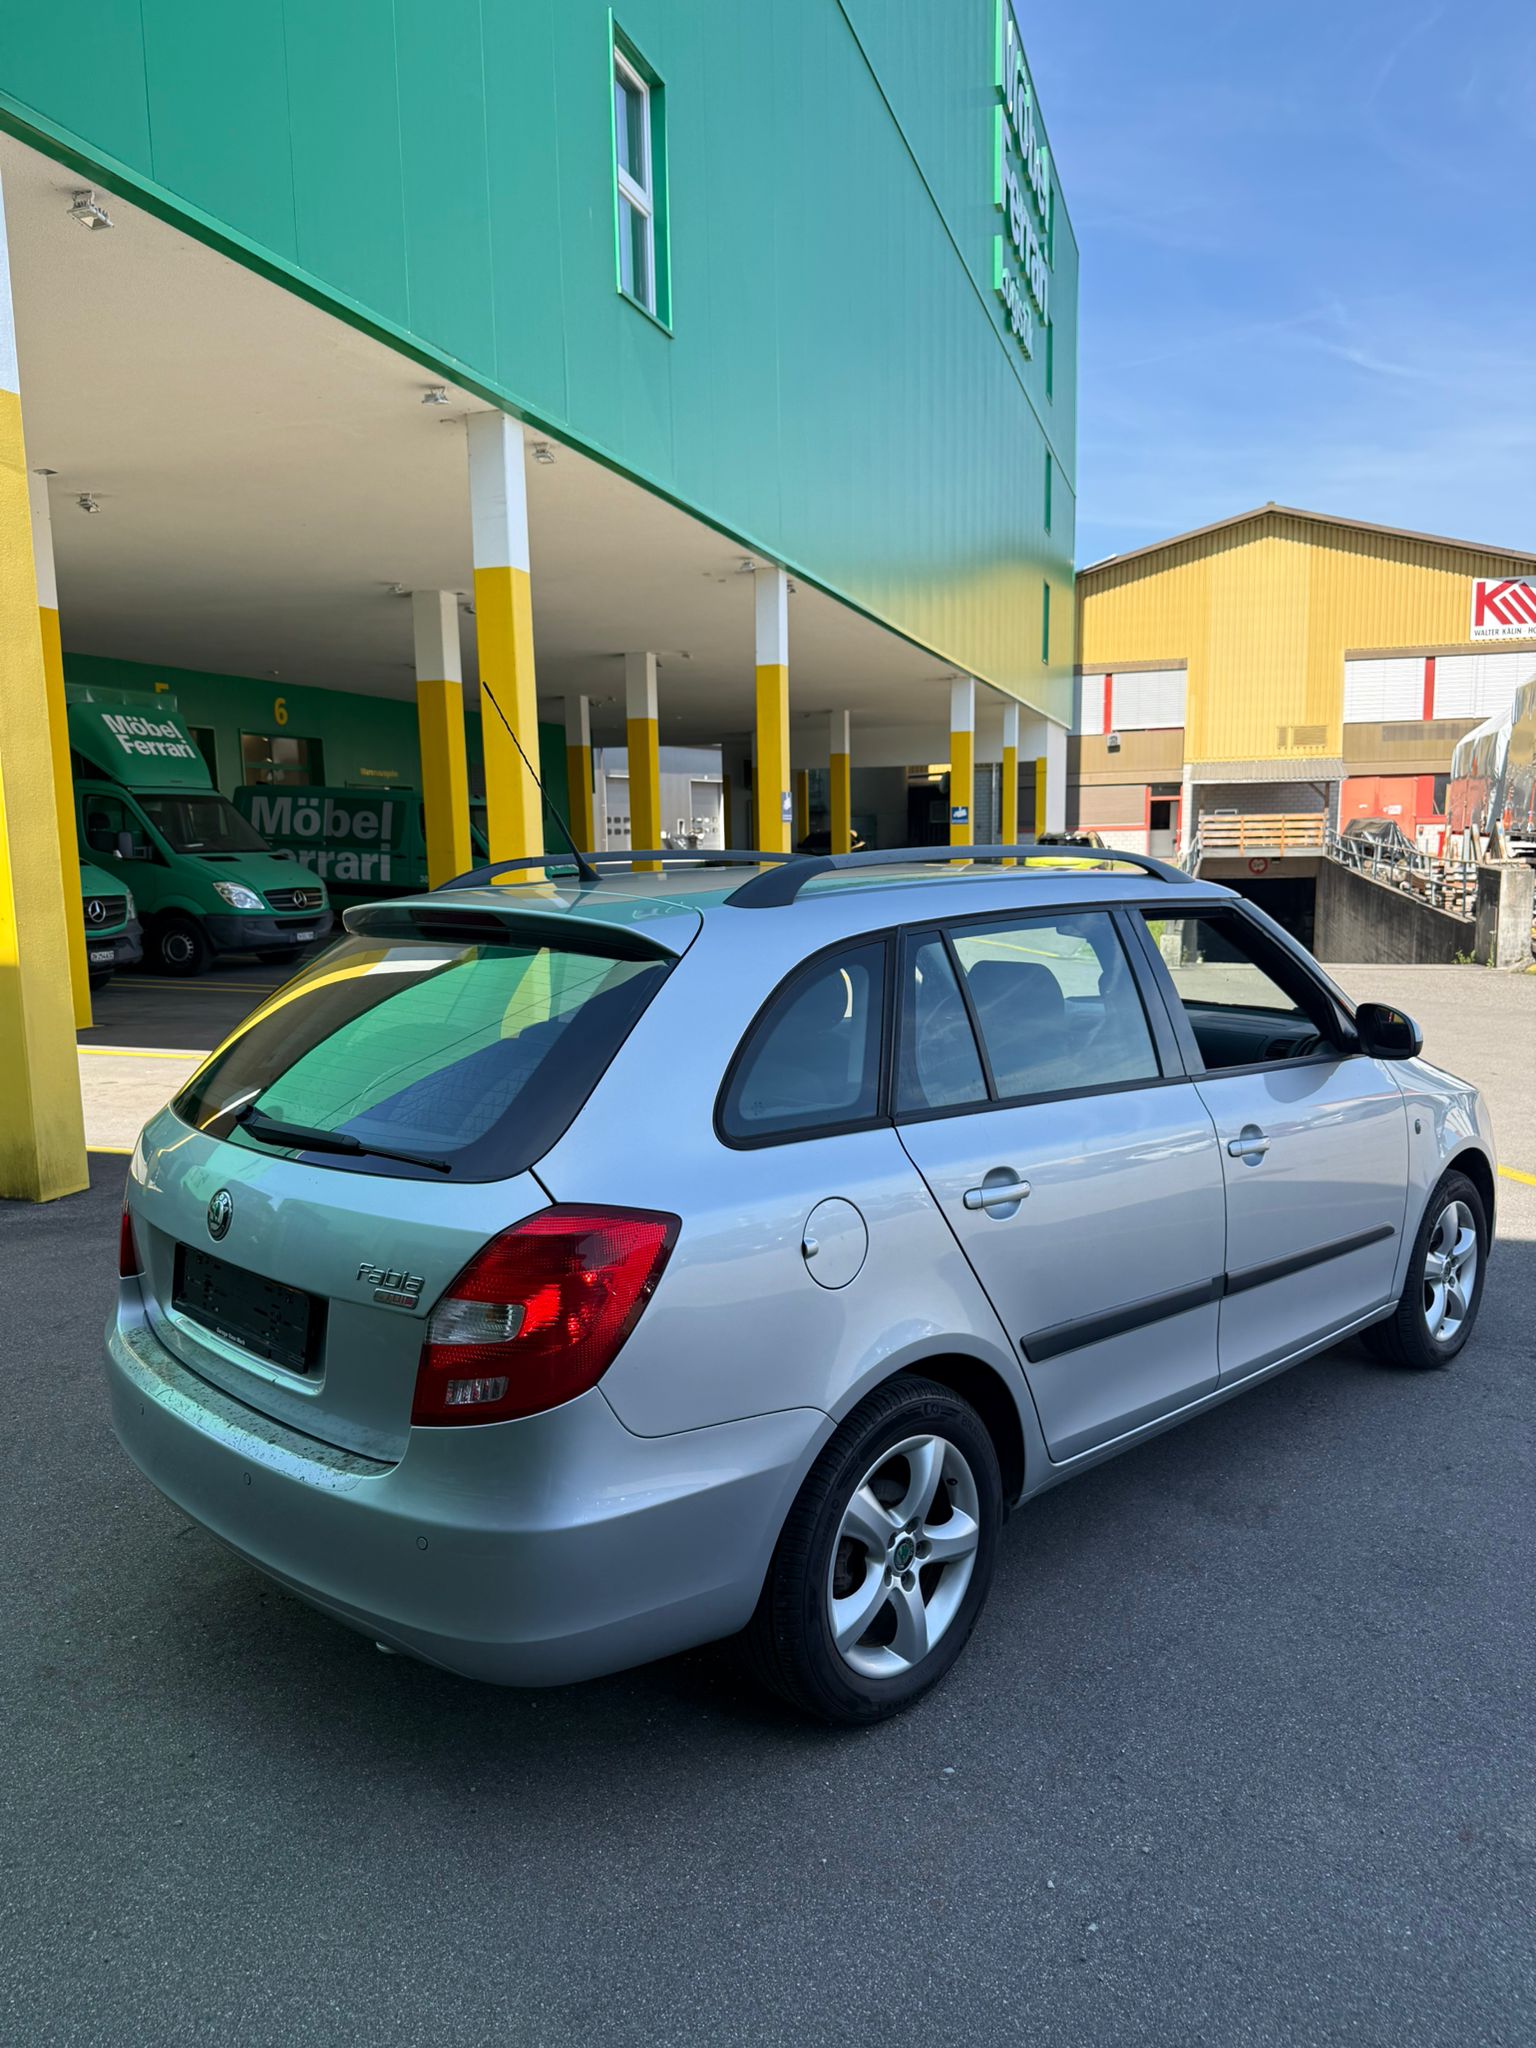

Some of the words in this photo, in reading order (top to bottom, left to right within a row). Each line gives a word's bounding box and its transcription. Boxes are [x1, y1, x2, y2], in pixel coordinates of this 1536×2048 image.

[995, 104, 1050, 327] Ferrari
[1474, 628, 1500, 637] WALTER
[101, 713, 184, 740] Möbel
[273, 697, 288, 726] 6
[116, 734, 197, 759] Ferrari
[250, 795, 394, 841] Möbel
[266, 840, 392, 881] rrari
[356, 1261, 425, 1294] Fabia
